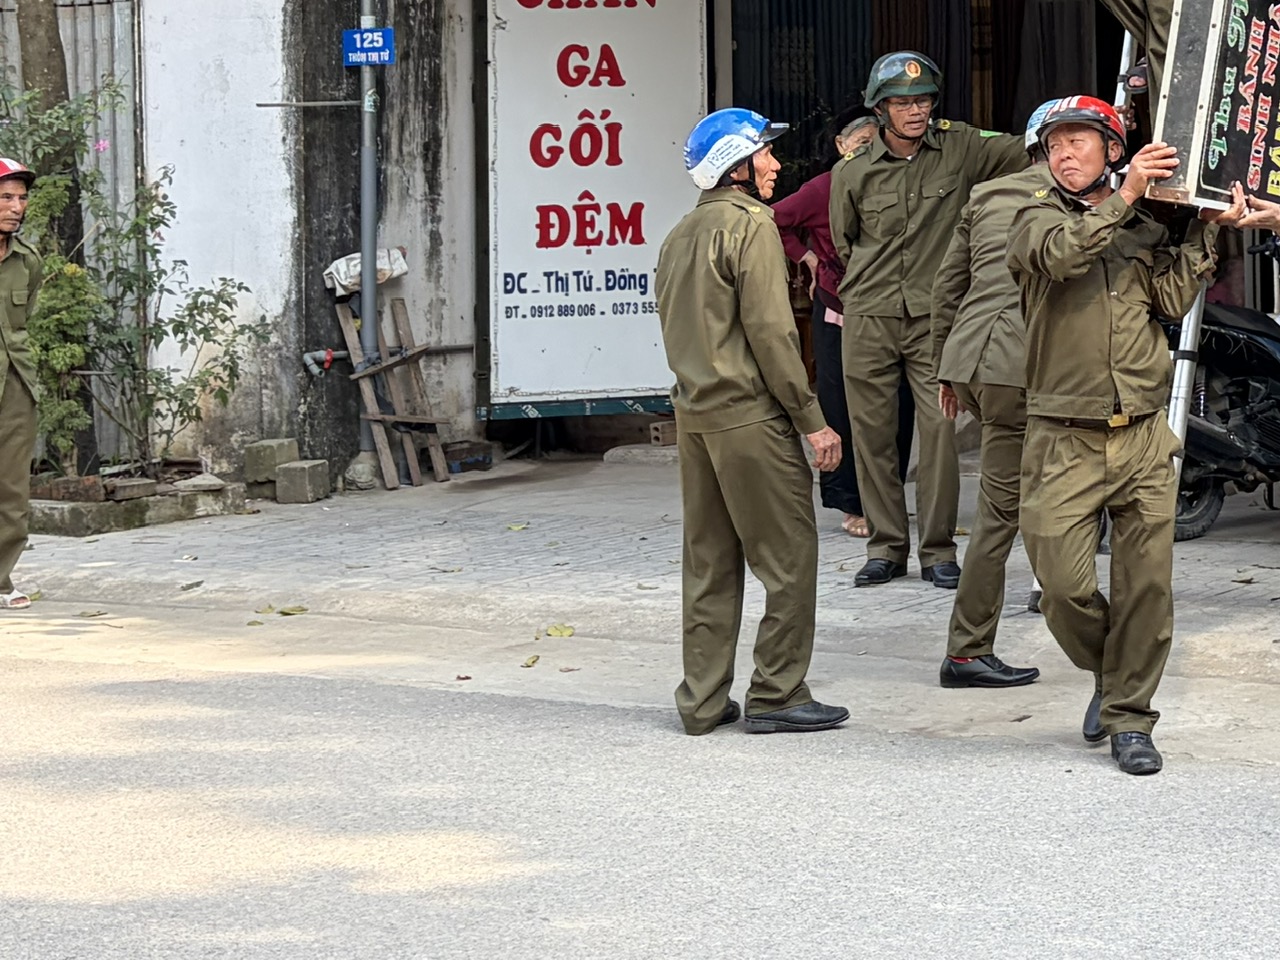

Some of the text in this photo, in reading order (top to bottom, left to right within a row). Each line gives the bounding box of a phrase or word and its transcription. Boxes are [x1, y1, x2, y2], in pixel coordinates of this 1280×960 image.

[352, 31, 384, 49] 125
[556, 43, 627, 87] GA
[1236, 16, 1266, 134] BÁNH
[529, 108, 624, 168] GỐI
[1208, 66, 1238, 171] Thu
[1246, 92, 1272, 191] SINH
[534, 189, 648, 256] ĐỆM
[530, 304, 555, 318] 0912
[557, 303, 576, 318] 889
[577, 303, 596, 317] 006
[611, 301, 639, 316] 0373
[542, 270, 570, 297] Thị
